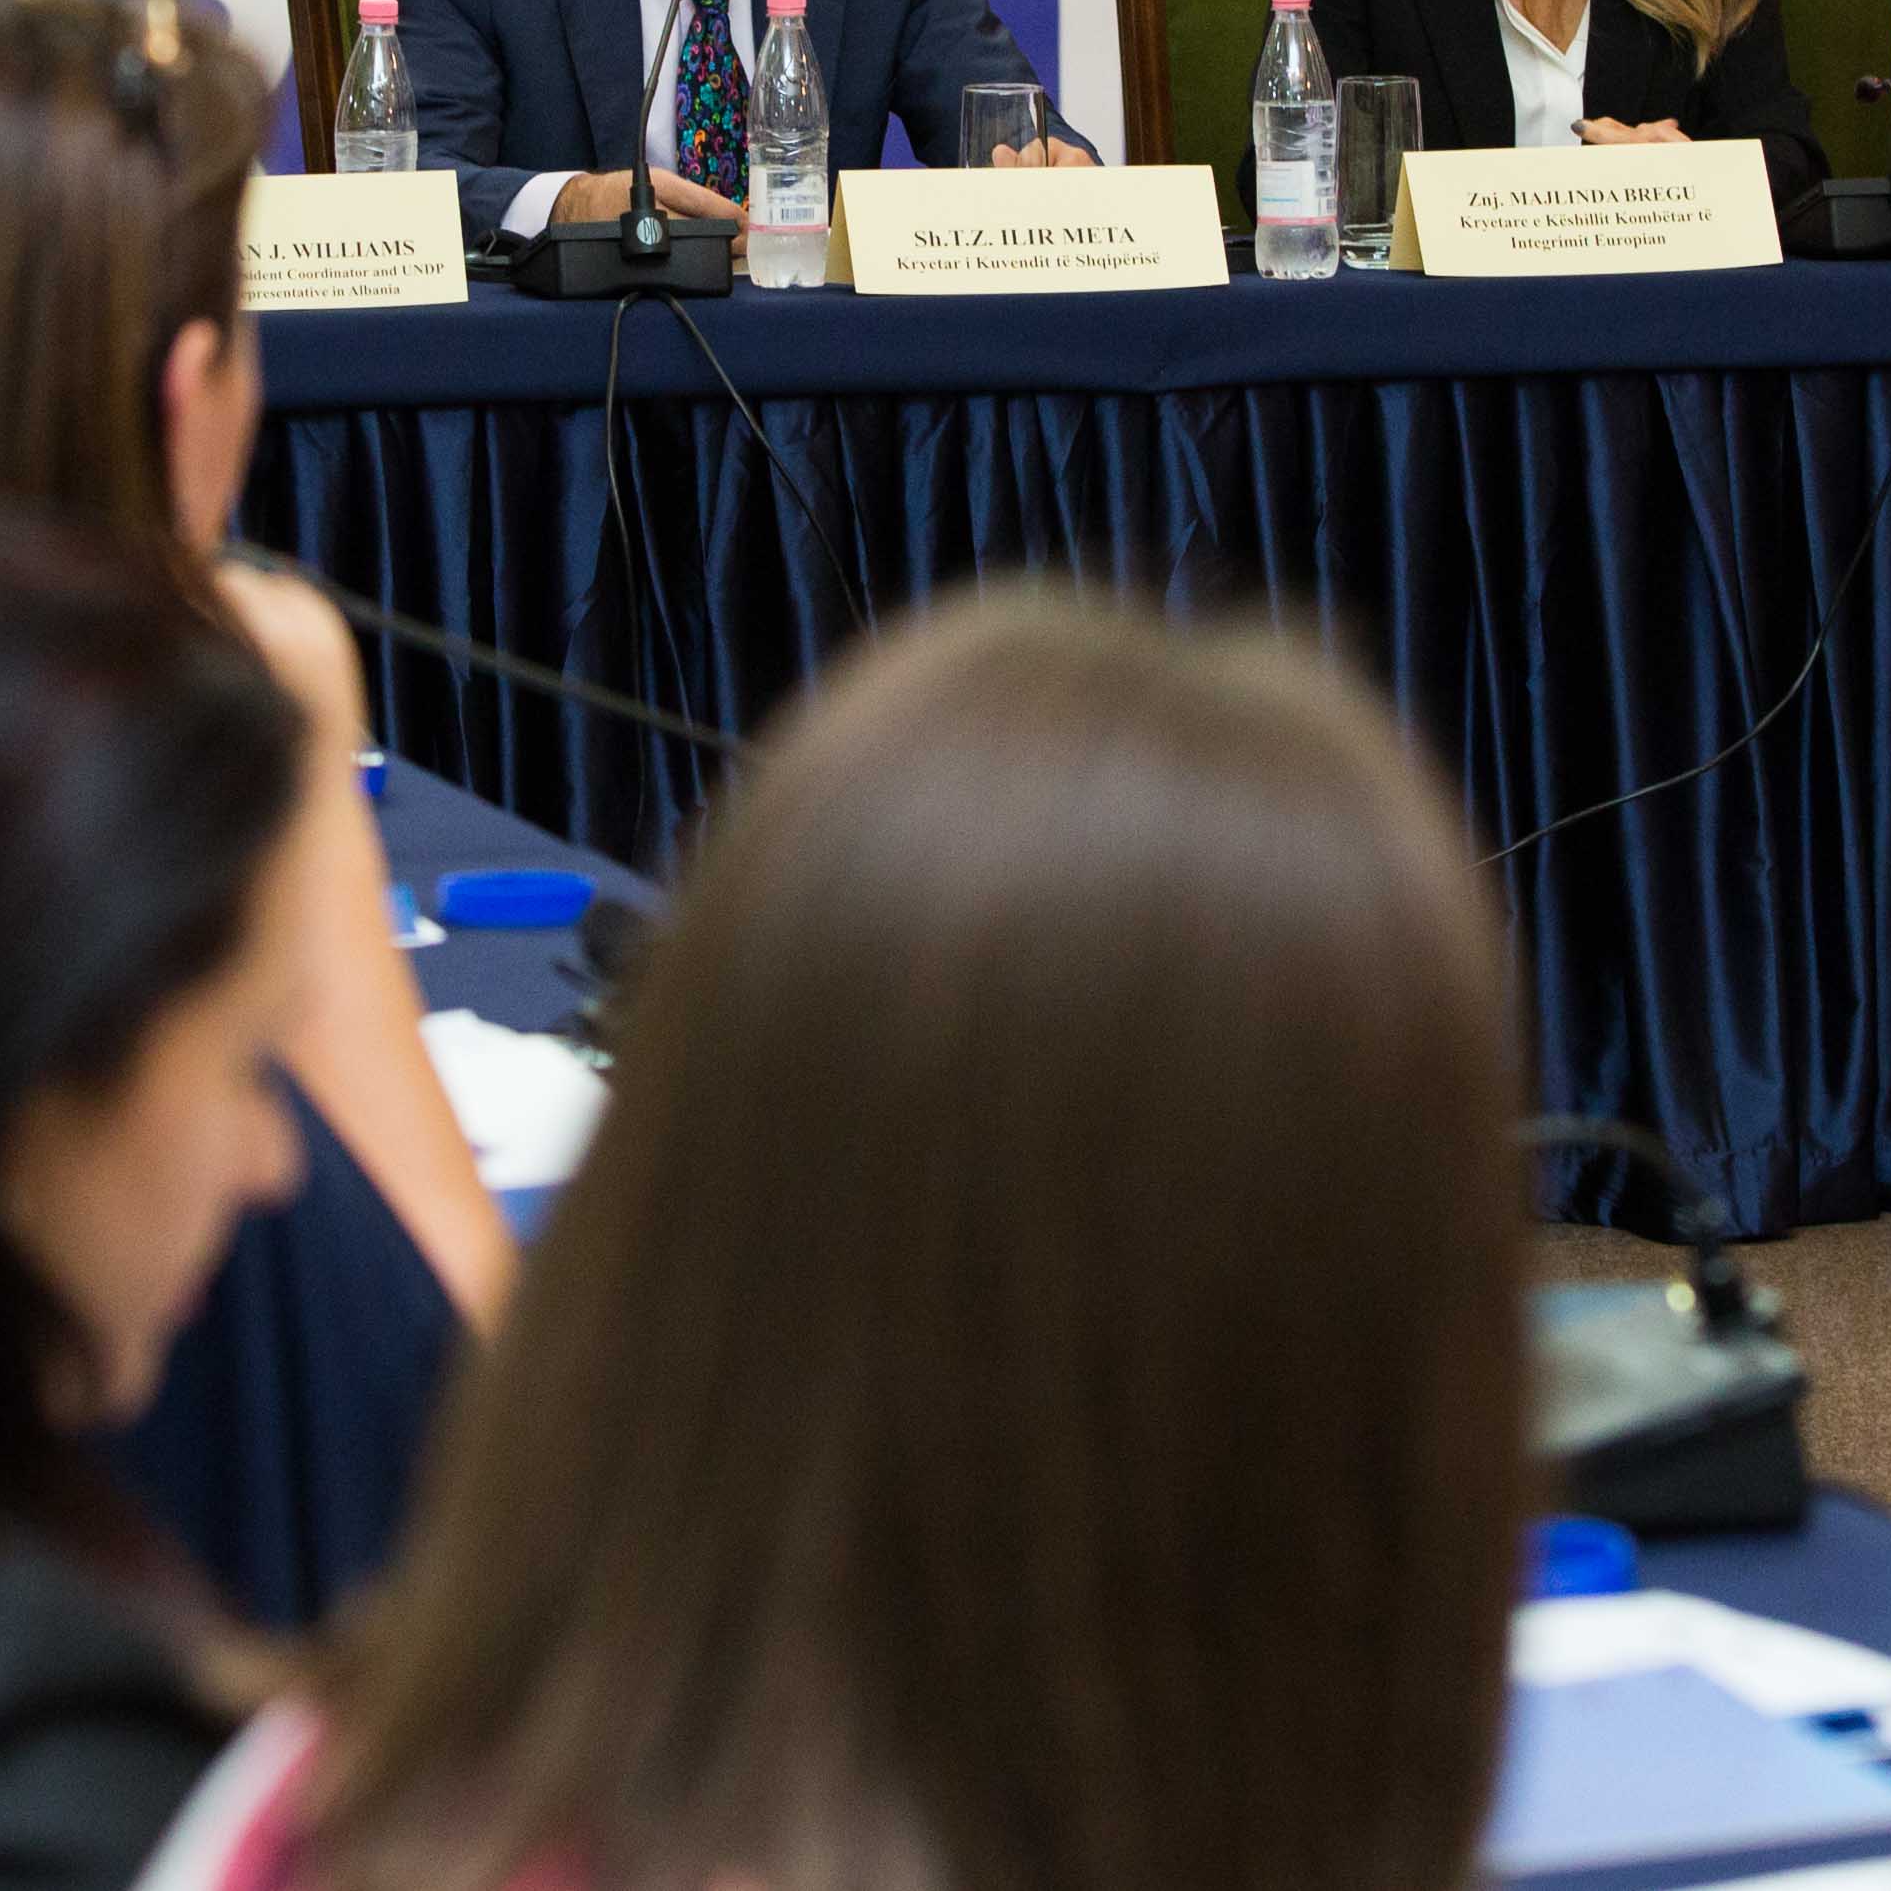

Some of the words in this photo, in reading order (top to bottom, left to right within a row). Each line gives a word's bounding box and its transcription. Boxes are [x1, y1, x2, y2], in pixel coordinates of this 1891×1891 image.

[1468, 192, 1504, 210] Znj.
[1510, 189, 1619, 206] MAJLINDA
[1624, 185, 1695, 203] BREGU
[1460, 215, 1528, 232] Kryetare
[1533, 218, 1541, 227] e
[1546, 213, 1610, 227] Këshillit
[1615, 210, 1693, 225] Kombëtar
[1698, 208, 1712, 222] të
[914, 229, 993, 247] Sh.T.Z.
[1001, 228, 1055, 246] ILIR
[1063, 227, 1135, 245] META
[1511, 235, 1589, 251] Integrimit
[1595, 233, 1666, 249] Europian
[269, 244, 286, 260] J.
[293, 239, 415, 259] WILLIAMS
[242, 267, 282, 281] sident
[287, 265, 368, 280] Coordinator
[373, 264, 398, 278] and
[402, 262, 445, 277] UNDP
[897, 256, 960, 273] Kryetar
[977, 255, 1050, 269] Kuvendit
[1057, 254, 1070, 268] të
[1076, 252, 1160, 270] Shqipërisë
[241, 286, 328, 301] epresentative
[332, 286, 345, 297] in
[349, 284, 400, 297] Albania
